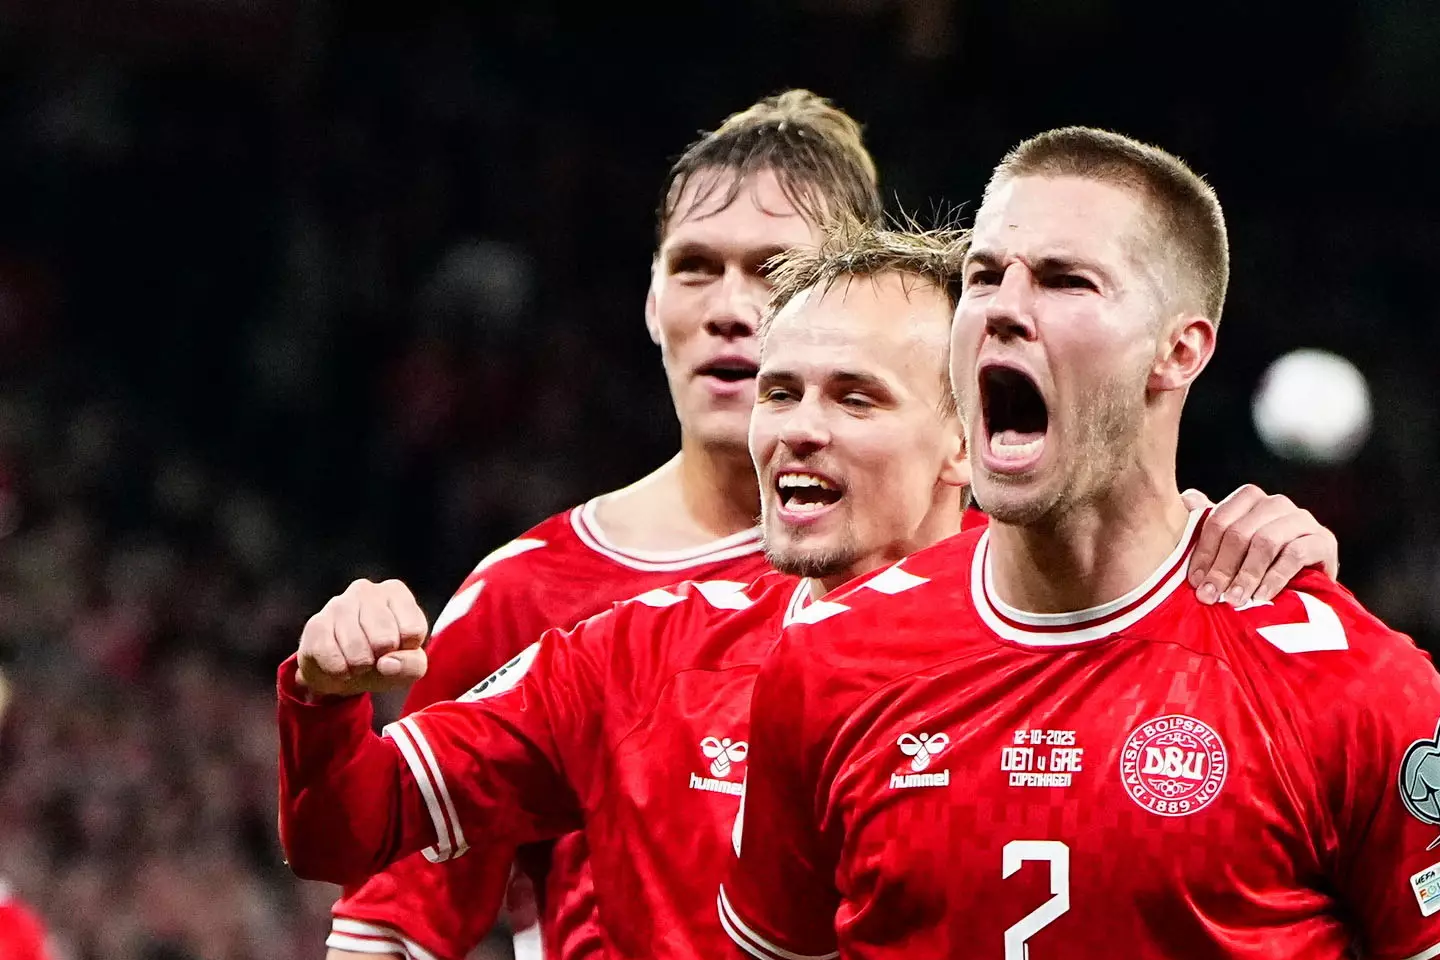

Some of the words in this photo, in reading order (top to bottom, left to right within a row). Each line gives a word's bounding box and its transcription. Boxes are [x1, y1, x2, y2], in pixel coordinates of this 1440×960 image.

[1013, 729, 1076, 745] 12-10-2025
[1001, 747, 1034, 771] DEN
[1050, 747, 1084, 771] GRE
[1124, 737, 1145, 798] DANSK
[1142, 746, 1206, 780] DBU
[889, 769, 949, 789] hummel
[1009, 772, 1072, 787] COPENHAGEN
[1147, 797, 1190, 813] 1889
[1415, 870, 1436, 886] UEFA
